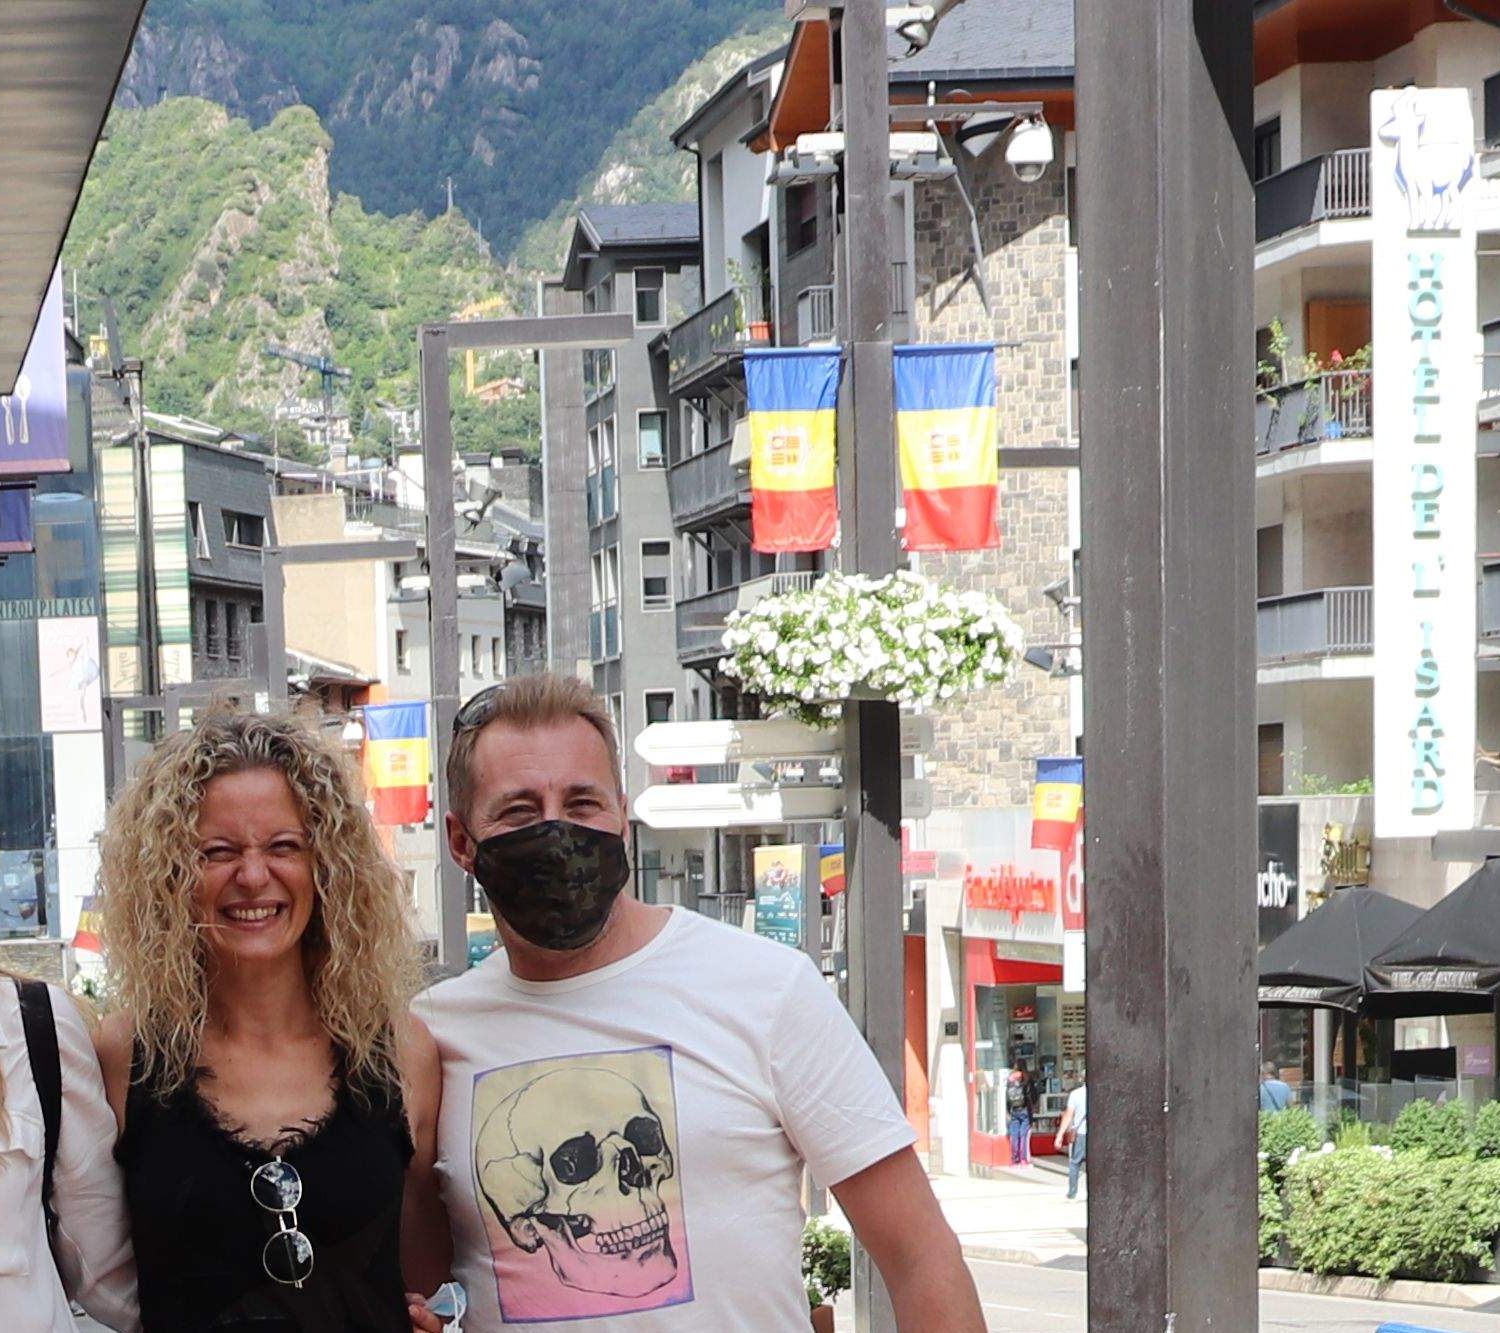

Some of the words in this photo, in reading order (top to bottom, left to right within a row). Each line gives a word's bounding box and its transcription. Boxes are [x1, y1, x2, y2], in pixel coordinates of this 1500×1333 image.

[1405, 251, 1445, 444] HOTEL
[1410, 463, 1446, 540] DE
[38, 598, 94, 618] PILATES
